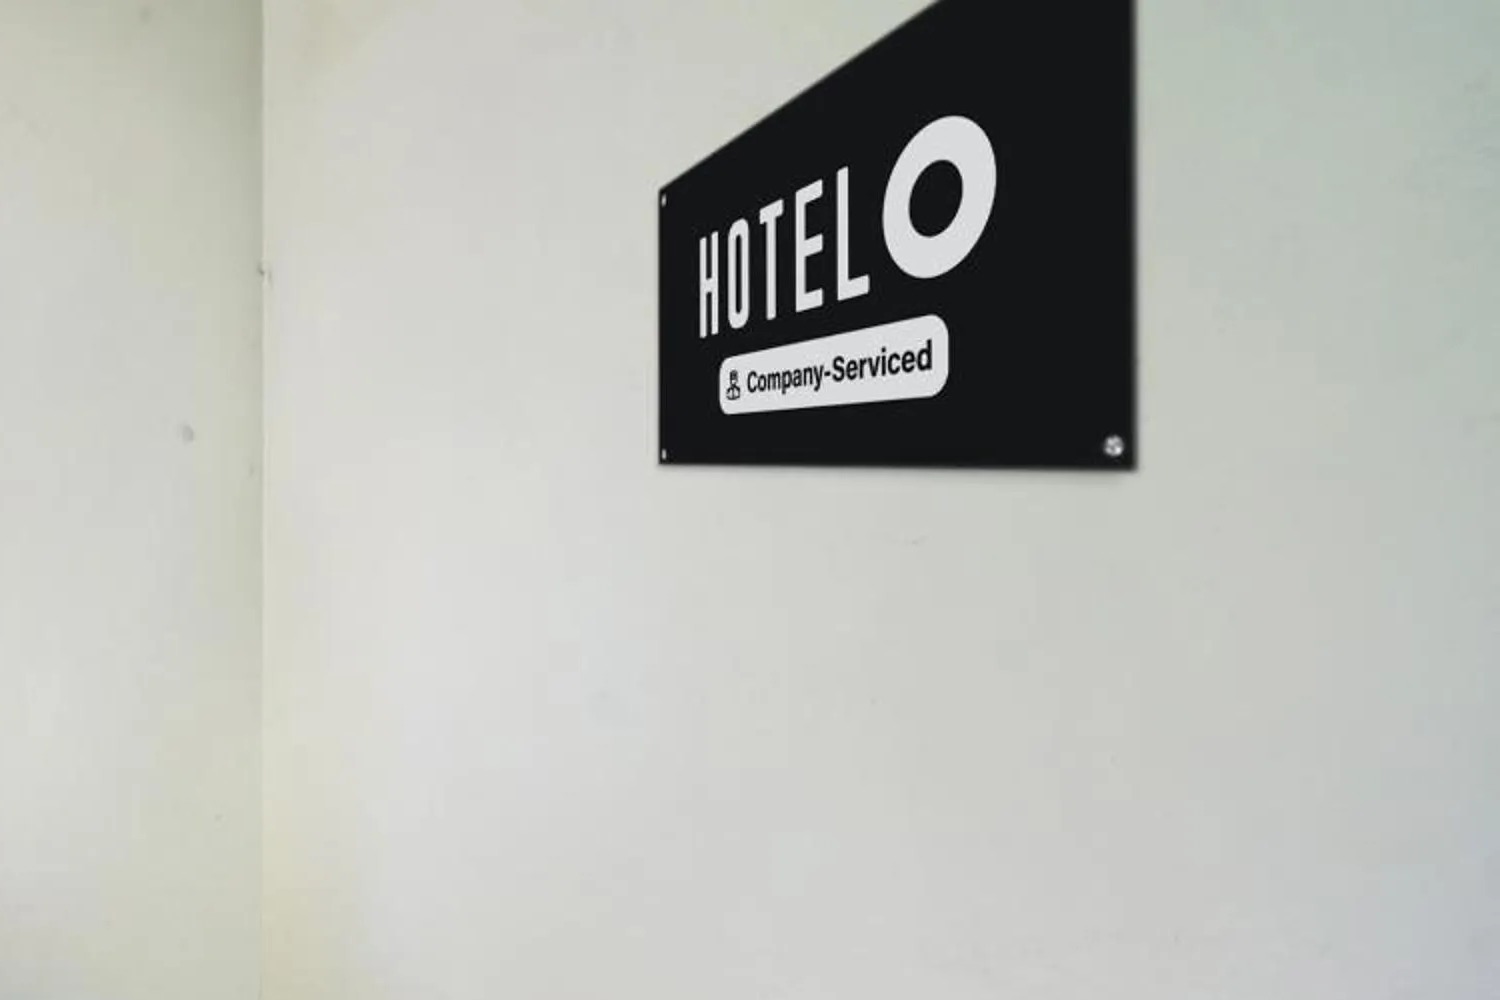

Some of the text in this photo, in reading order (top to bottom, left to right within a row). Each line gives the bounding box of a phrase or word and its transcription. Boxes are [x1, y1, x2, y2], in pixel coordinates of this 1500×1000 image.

[699, 115, 997, 338] HOTEL O
[746, 338, 933, 395] Company-Serviced
